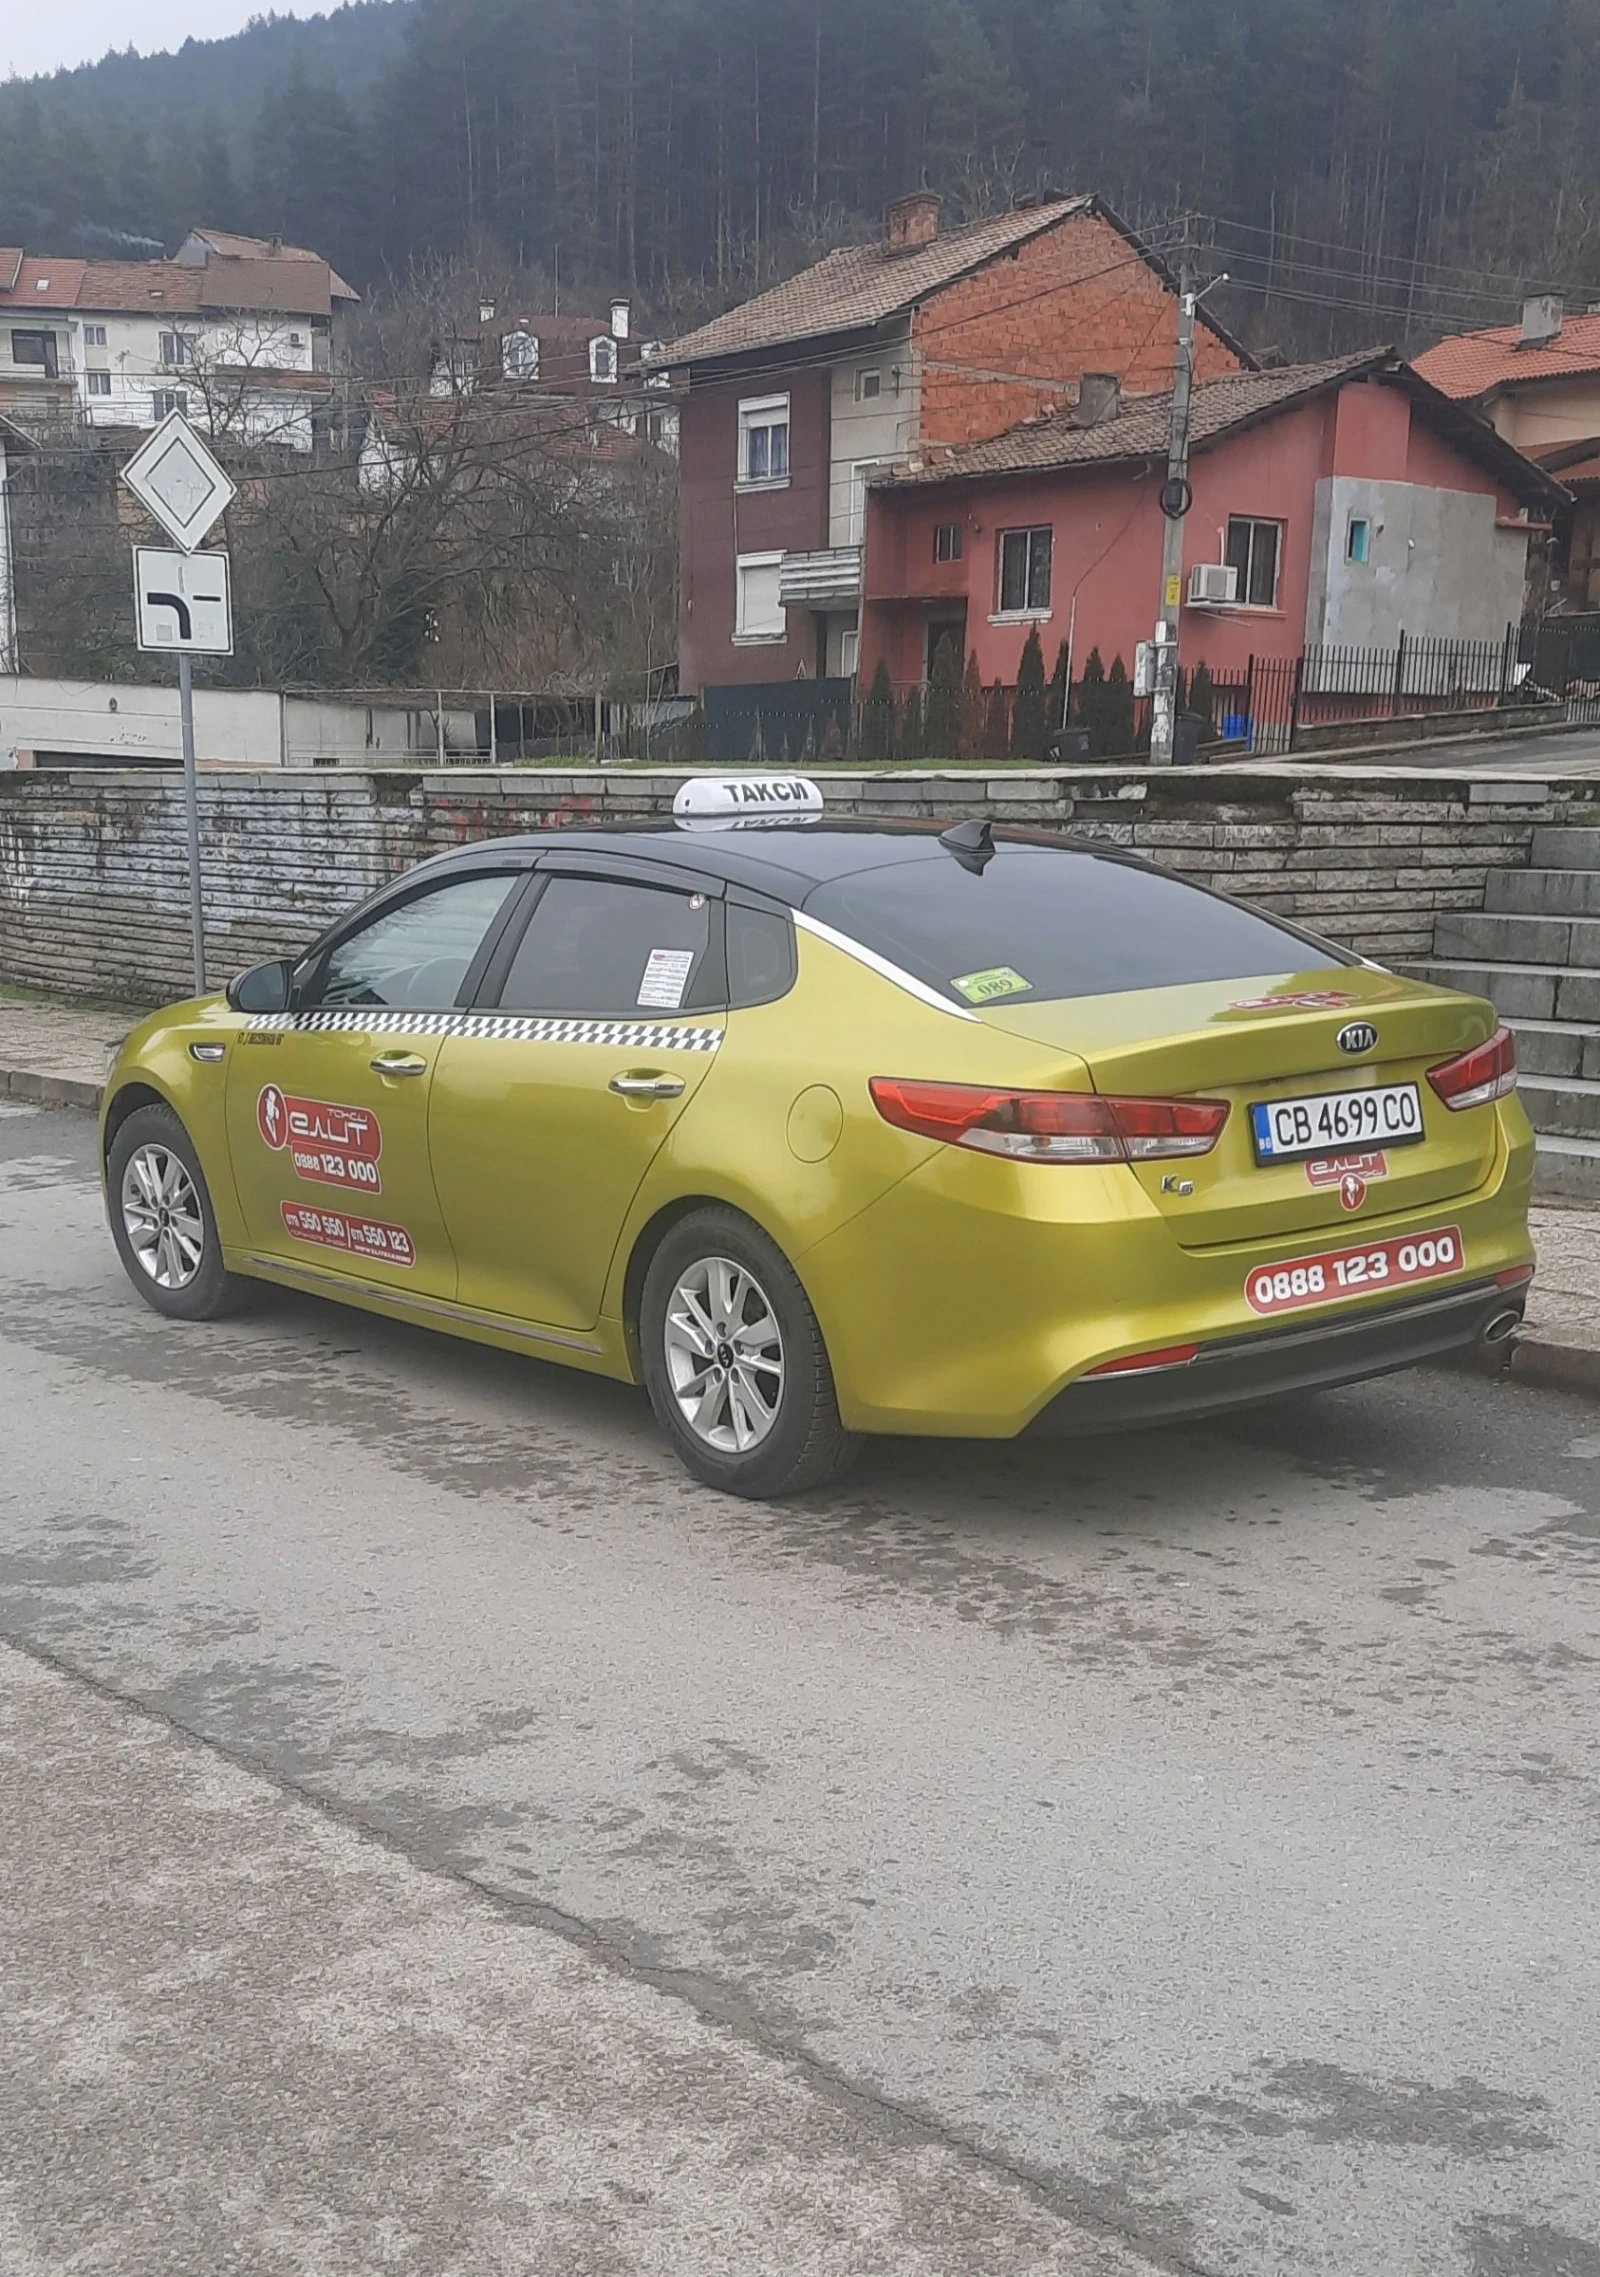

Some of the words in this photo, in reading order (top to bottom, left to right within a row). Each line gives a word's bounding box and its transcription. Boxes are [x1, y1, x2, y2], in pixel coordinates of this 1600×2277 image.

[722, 782, 809, 803] ТАКСИ
[1345, 1030, 1374, 1049] KIA
[1275, 1107, 1311, 1146] CB
[1318, 1097, 1378, 1140] 4699
[1383, 1092, 1416, 1131] CO
[1258, 1136, 1272, 1151] BG
[320, 1154, 346, 1178] 123
[348, 1159, 377, 1184] 000
[298, 1210, 322, 1232] 550
[321, 1216, 345, 1237] 550
[362, 1225, 387, 1247] 550
[387, 1230, 410, 1253] 123
[1254, 1268, 1325, 1303] 0888
[1332, 1250, 1389, 1286] 123
[1398, 1236, 1455, 1272] 000
